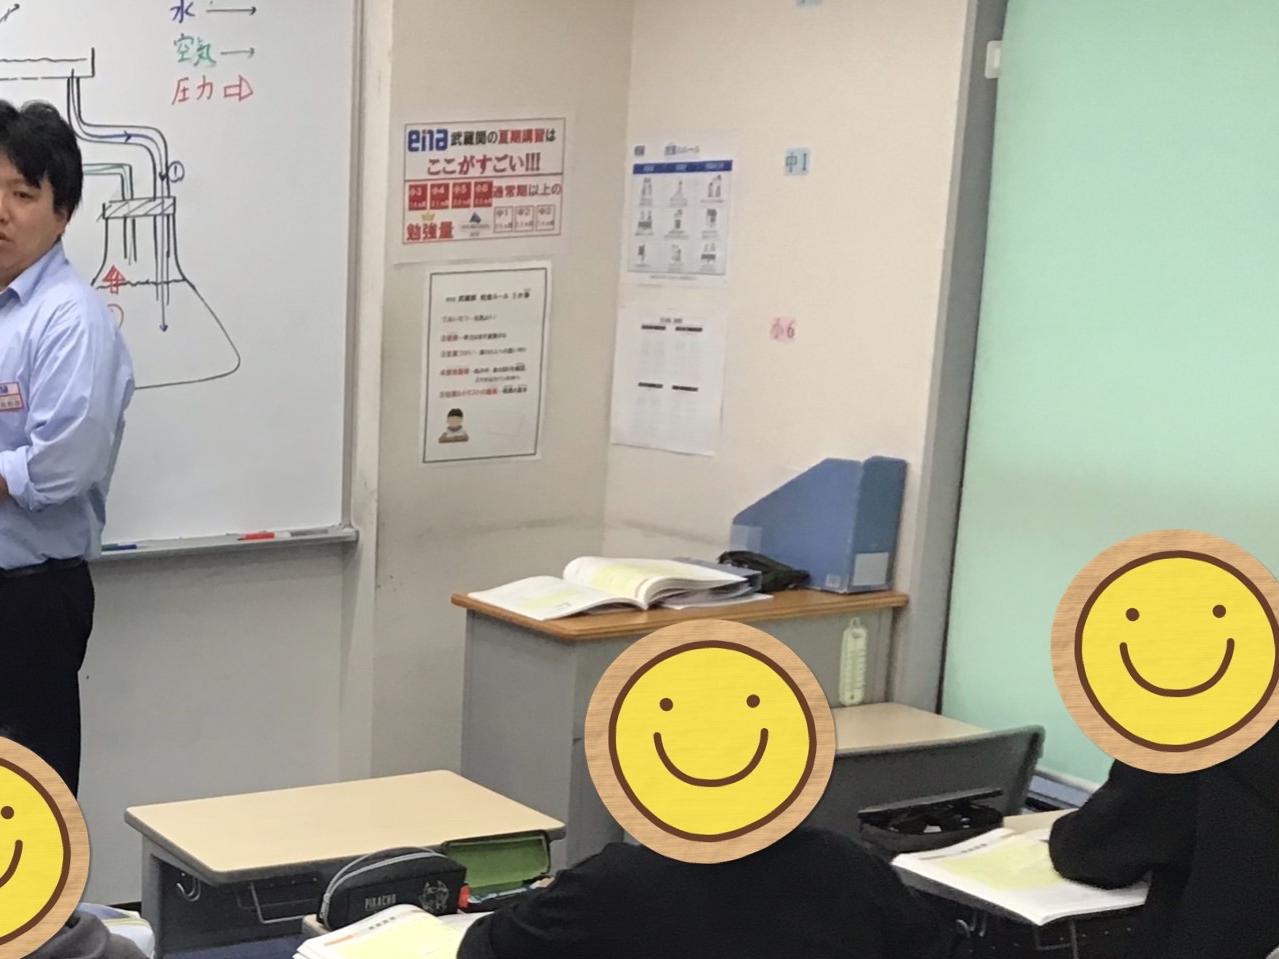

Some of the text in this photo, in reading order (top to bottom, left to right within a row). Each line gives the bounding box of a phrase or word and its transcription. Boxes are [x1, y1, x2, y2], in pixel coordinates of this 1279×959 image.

[170, 0, 196, 23] 水
[173, 33, 217, 67] 空気
[171, 74, 214, 106] 圧力
[407, 129, 449, 152] ena
[785, 152, 808, 173] 中1
